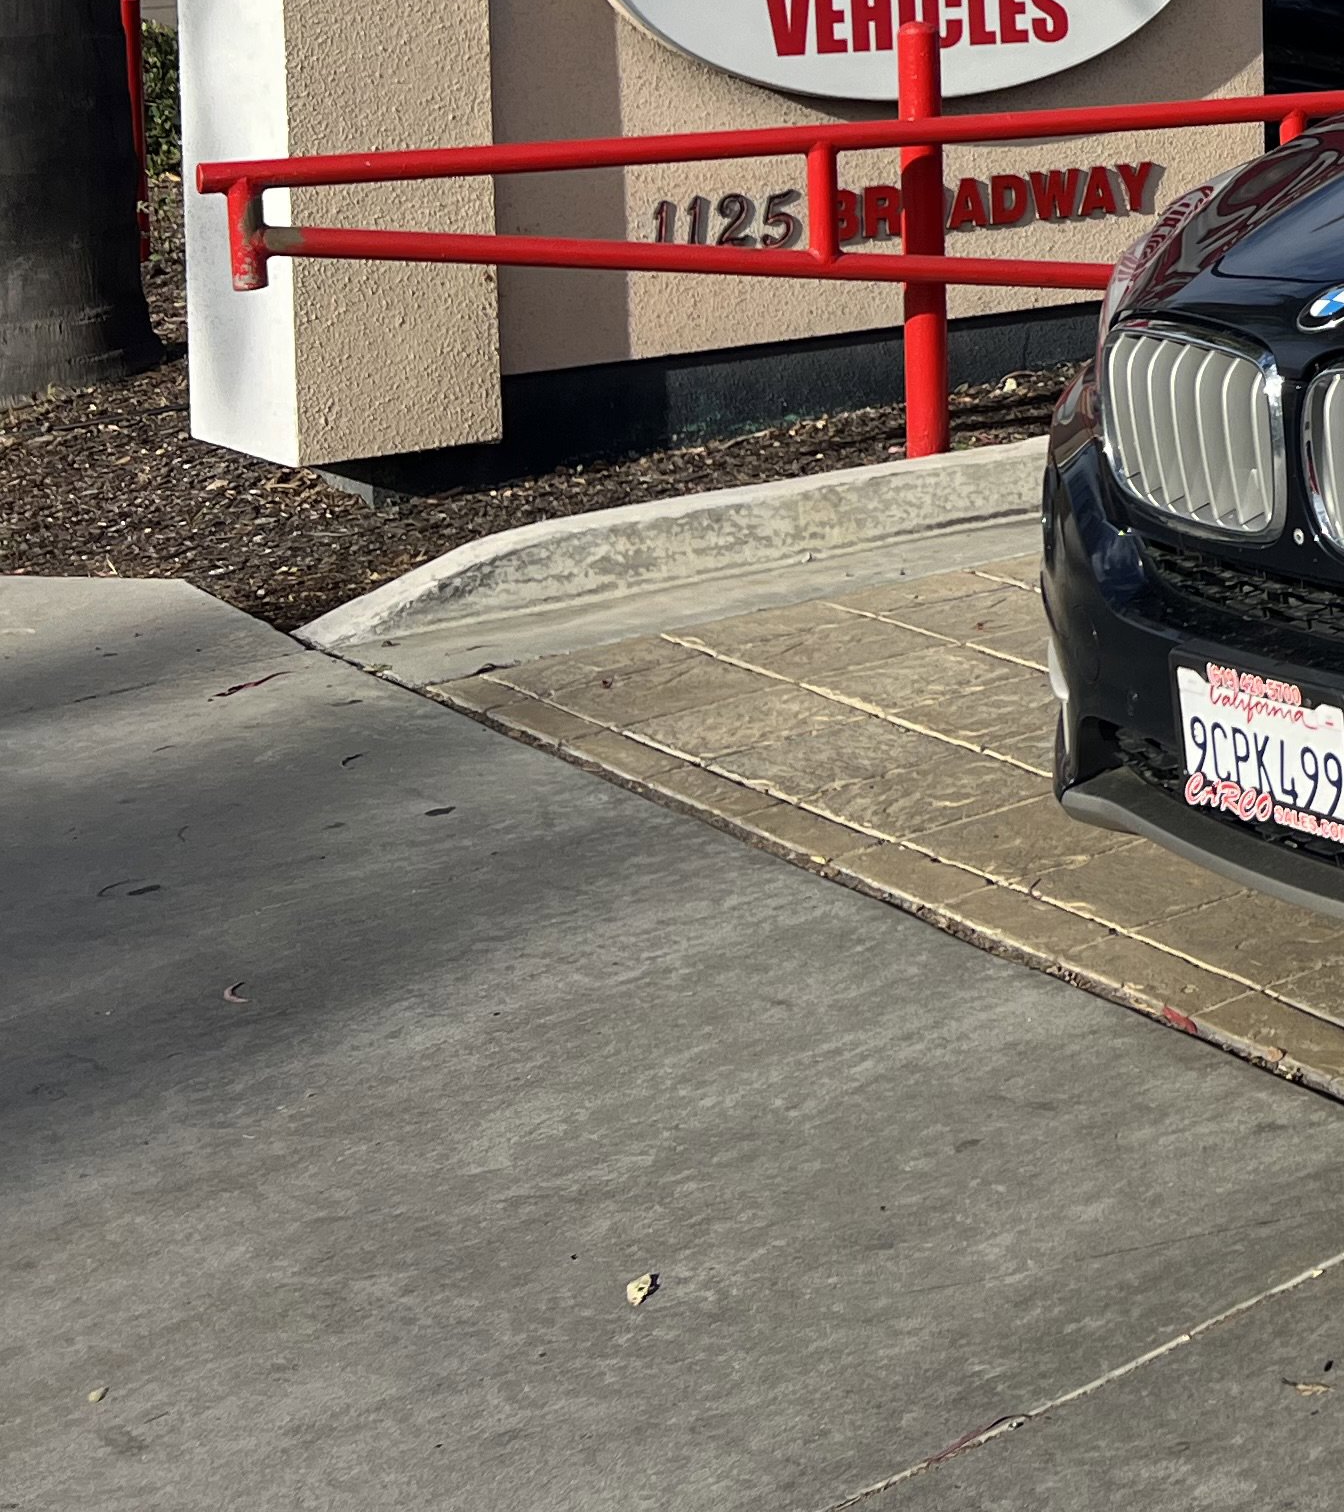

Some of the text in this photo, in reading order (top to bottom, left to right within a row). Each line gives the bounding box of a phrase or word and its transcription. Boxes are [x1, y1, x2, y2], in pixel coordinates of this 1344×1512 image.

[654, 161, 1155, 248] 1125 BRADWAY
[1209, 685, 1318, 730] California
